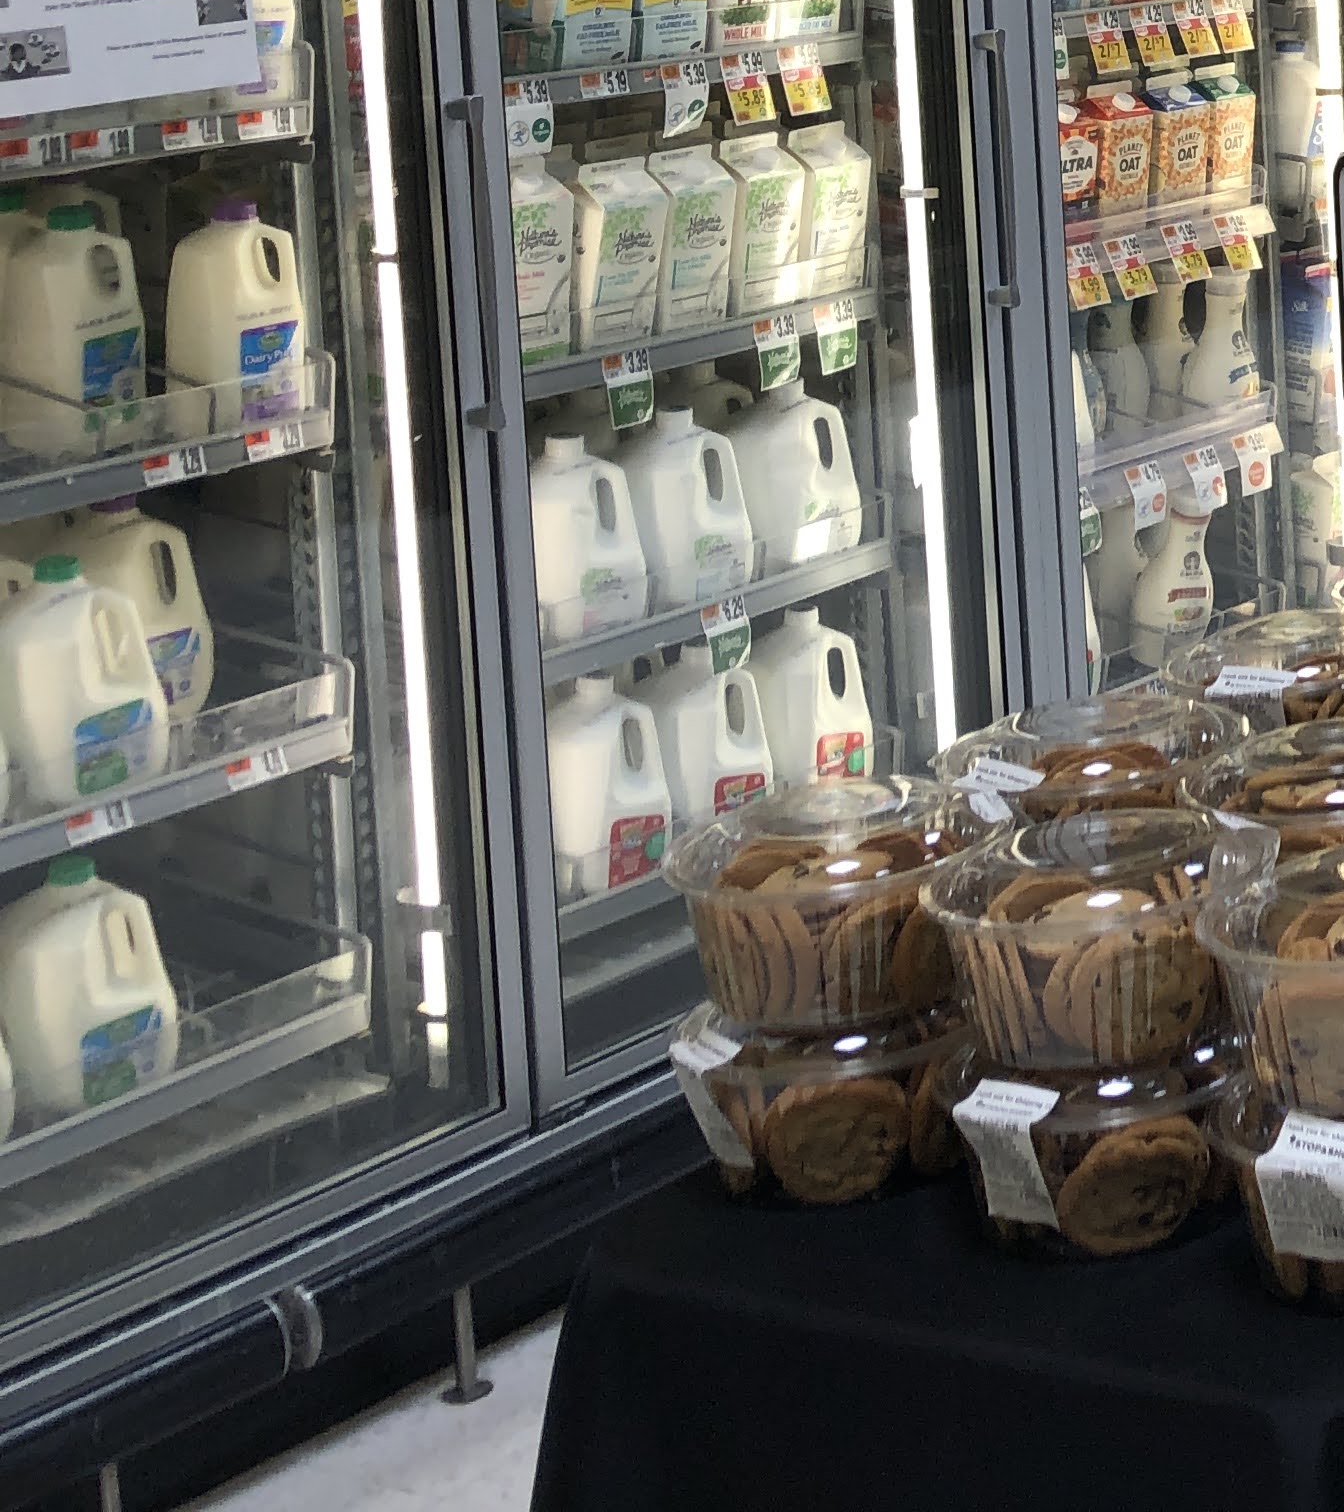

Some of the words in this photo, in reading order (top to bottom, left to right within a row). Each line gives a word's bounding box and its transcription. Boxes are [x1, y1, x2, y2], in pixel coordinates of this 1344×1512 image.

[724, 26, 749, 40] WHOLE
[1099, 42, 1121, 58] 2/$7
[1144, 36, 1165, 51] 2/$7
[523, 81, 548, 104] $5.39
[738, 89, 766, 106] $5.89
[1223, 121, 1246, 136] PLANET
[1177, 131, 1201, 147] PLANET
[1224, 134, 1244, 150] OAT
[1119, 142, 1144, 156] PLANET
[1177, 145, 1198, 162] OAT
[1119, 156, 1142, 173] OAT
[1180, 253, 1203, 269] $3.79
[1125, 271, 1148, 285] $3.79
[773, 313, 795, 339] $3.39
[624, 348, 649, 374] $3.39
